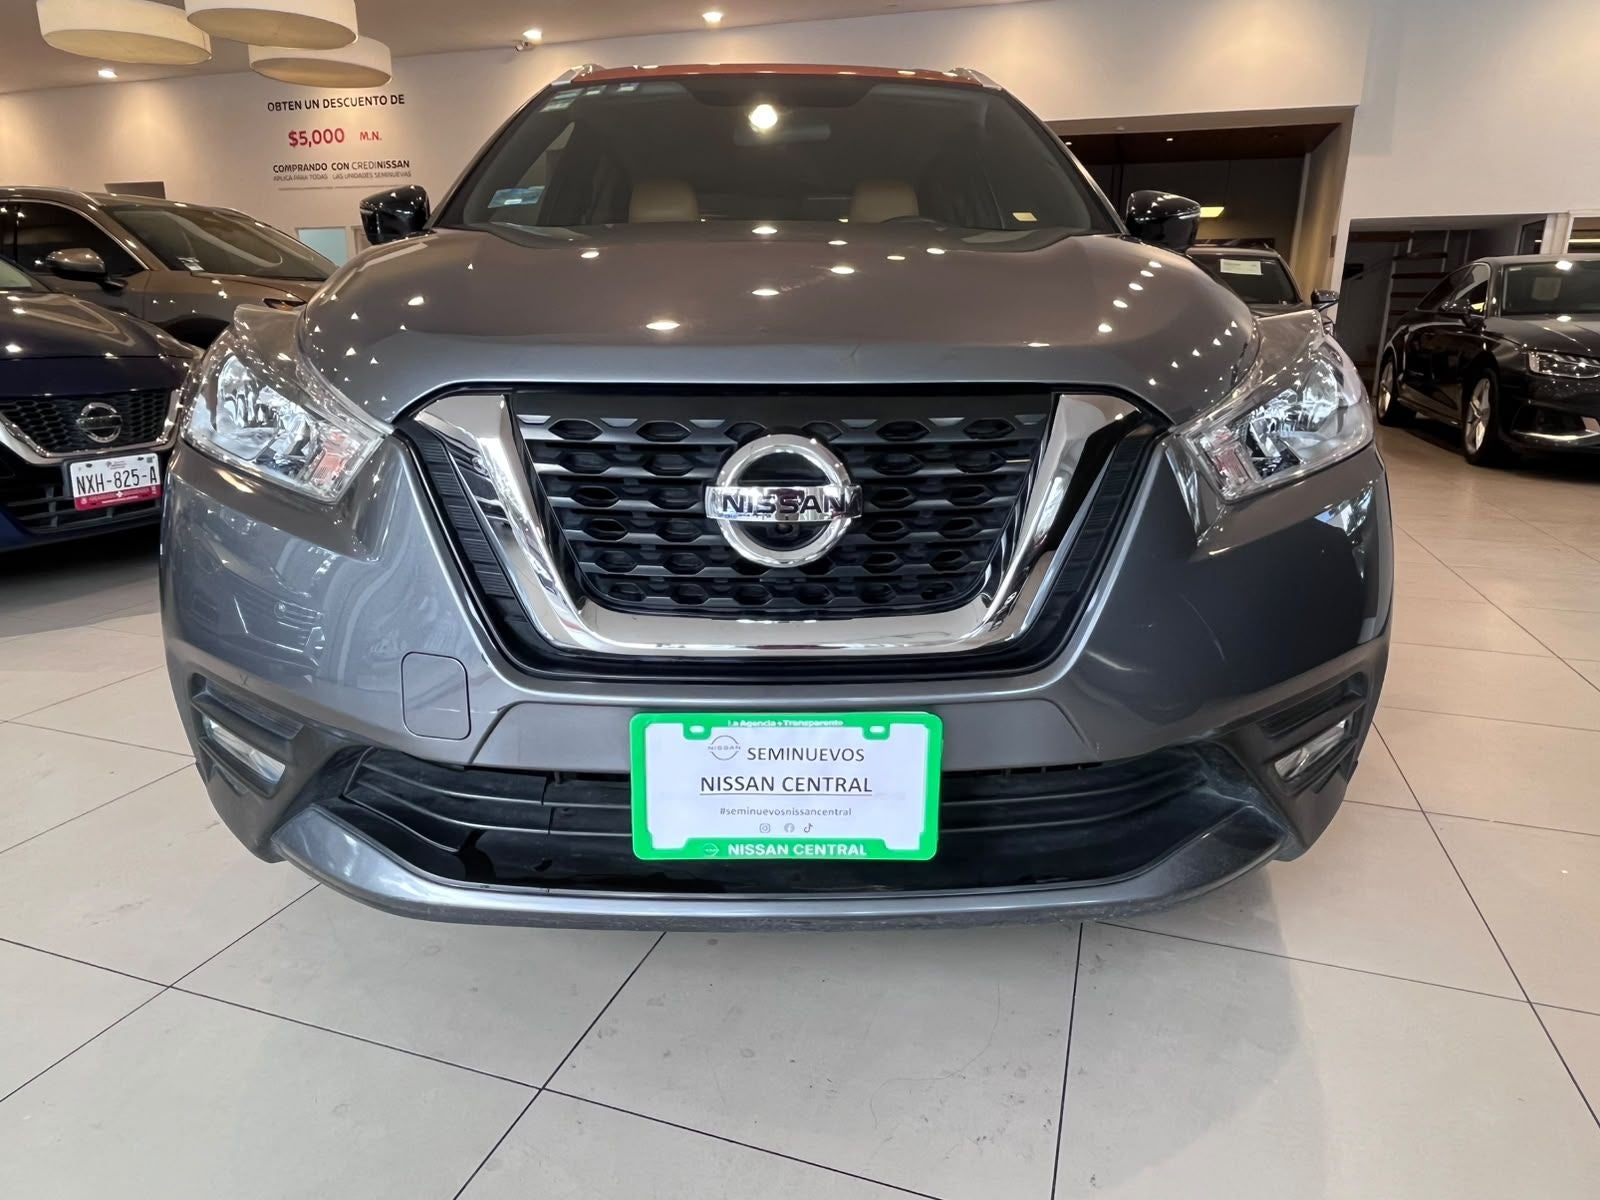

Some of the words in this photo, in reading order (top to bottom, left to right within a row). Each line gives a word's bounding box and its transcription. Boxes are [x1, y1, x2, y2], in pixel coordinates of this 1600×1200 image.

[267, 101, 302, 112] OBTEN
[304, 99, 320, 110] UN
[322, 95, 387, 109] DESCUENTO
[390, 94, 405, 105] DE
[288, 128, 345, 147] $5,000
[360, 131, 382, 141] M.N.
[272, 162, 328, 173] COMPRANDO
[331, 162, 350, 171] CON
[351, 160, 410, 170] CREDINISSAN
[77, 466, 157, 495] NXH-825-A
[722, 494, 846, 514] NISSAN
[747, 747, 865, 762] SEMINUEVOS
[701, 776, 775, 792] NISSAN
[782, 776, 873, 793] CENTRAL
[720, 806, 852, 816] #seminuevosnissancentral
[727, 843, 789, 856] NISSAN
[793, 843, 867, 856] CENTRAL
